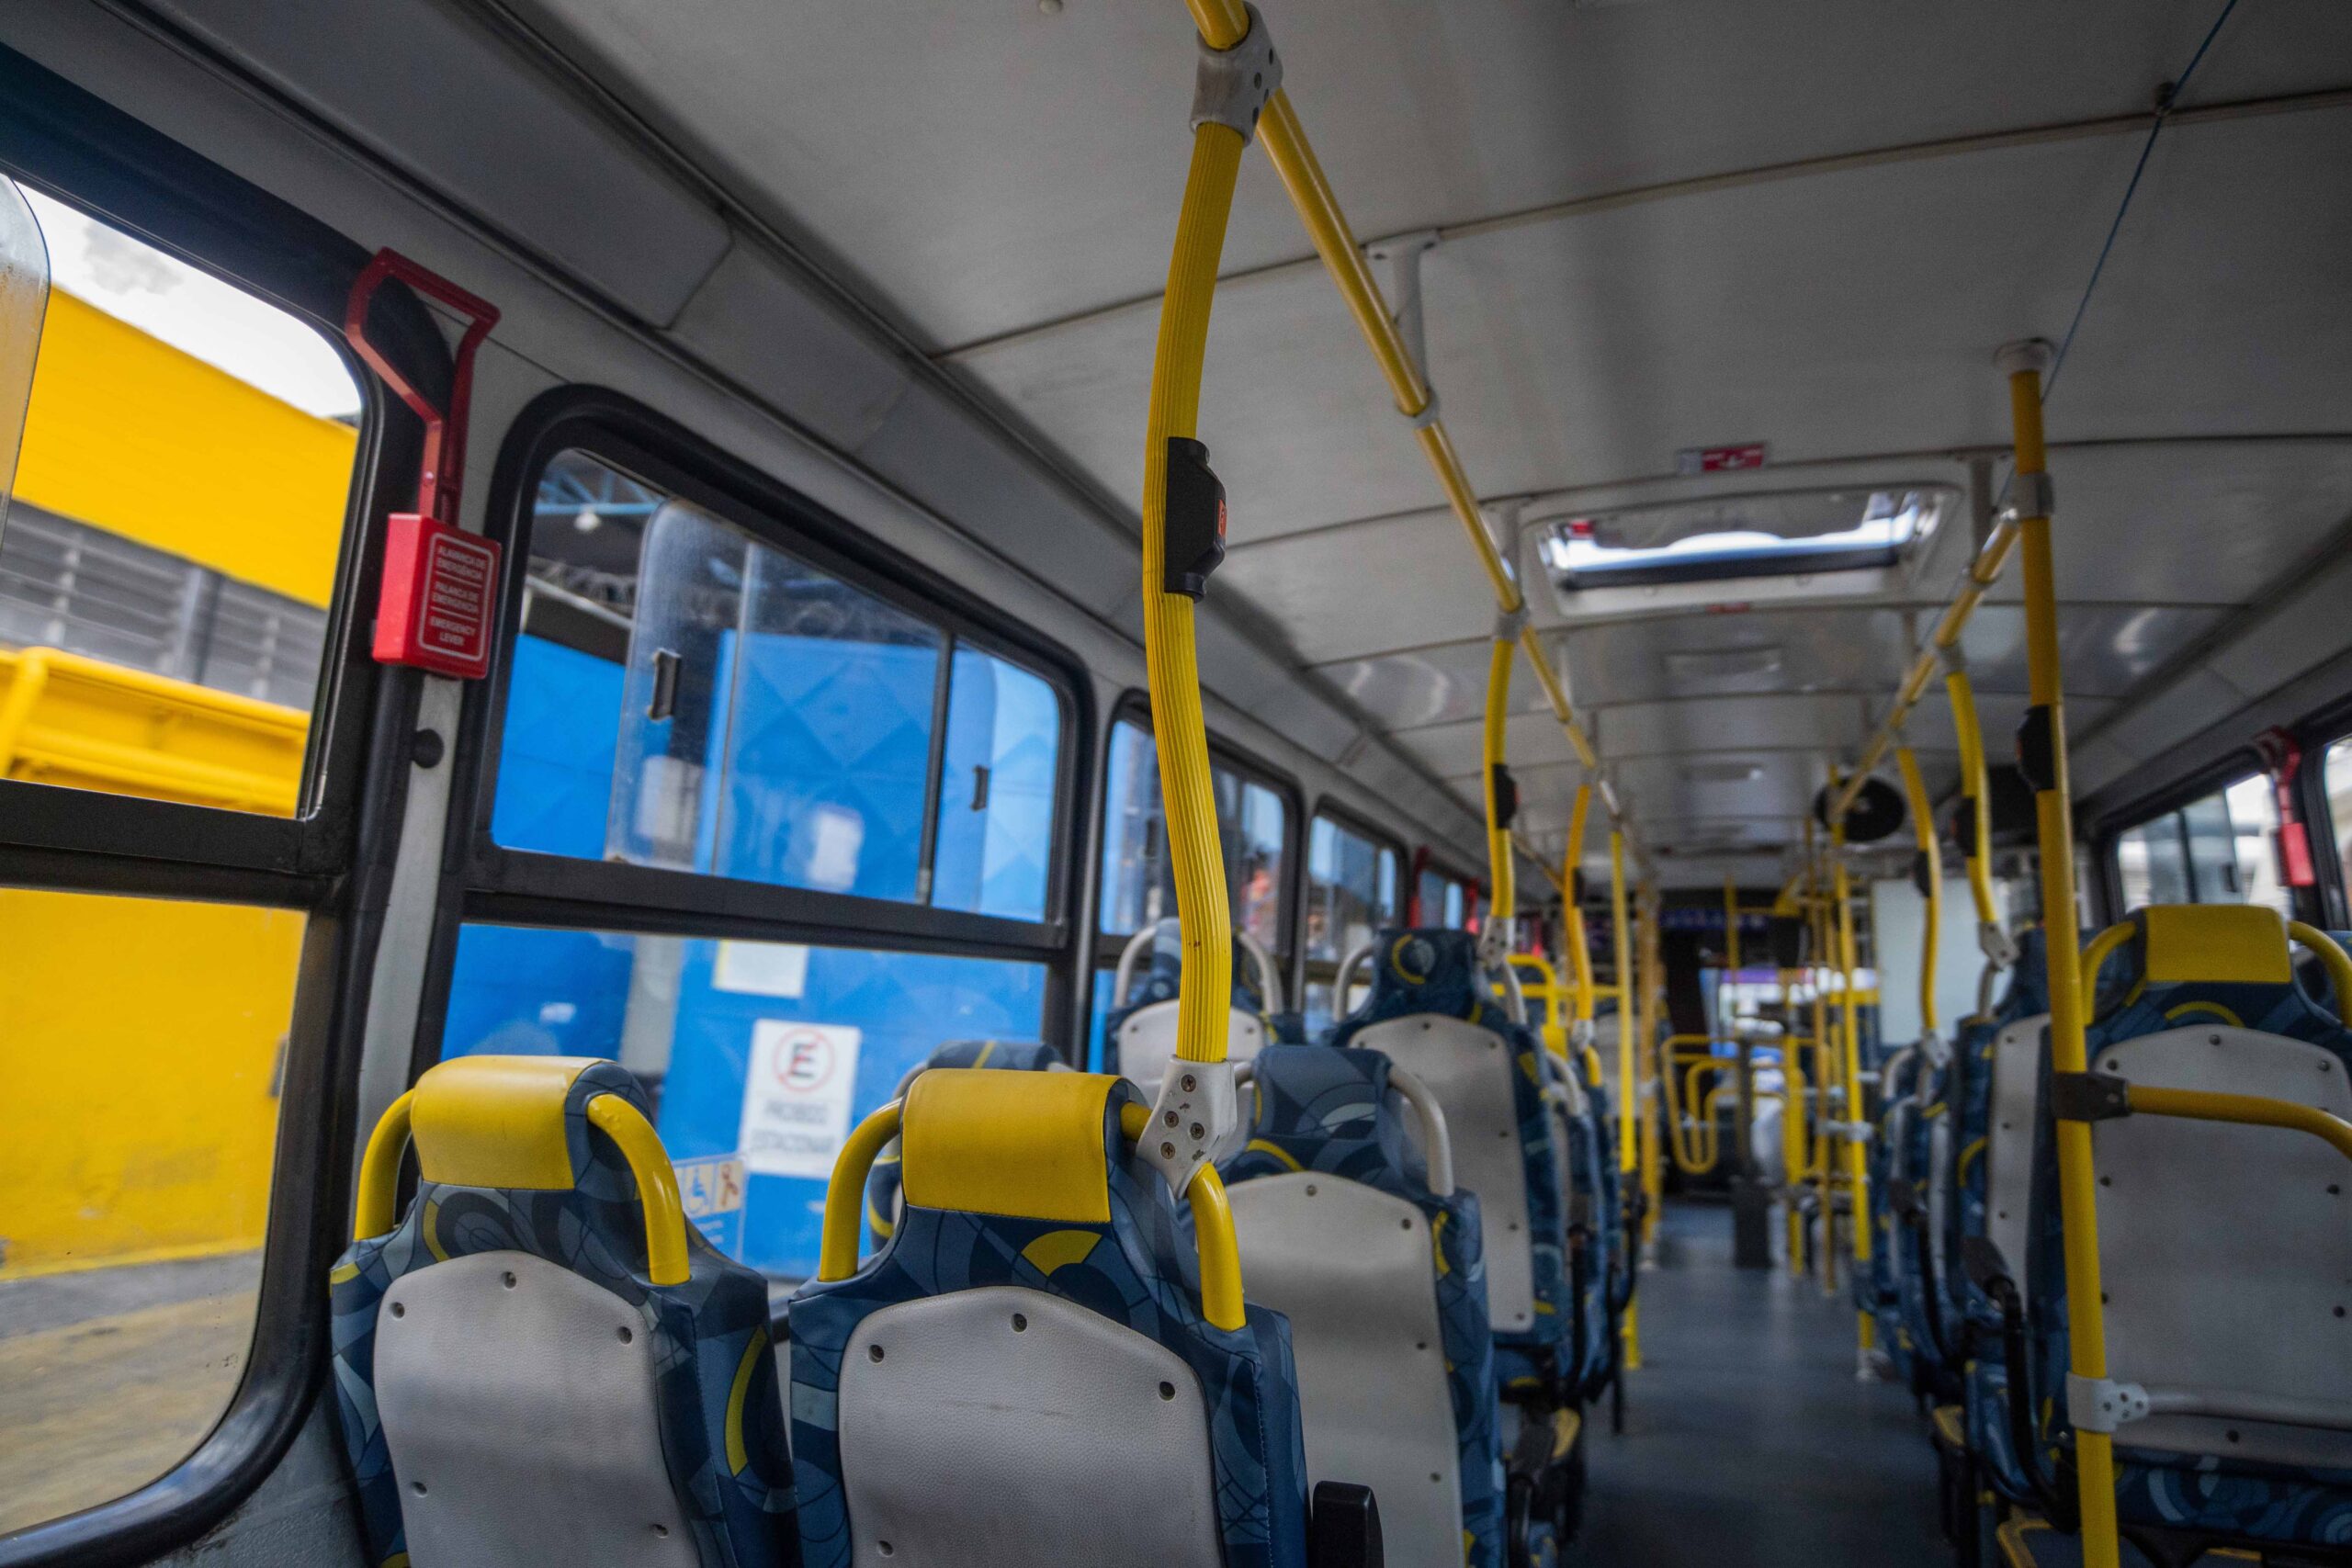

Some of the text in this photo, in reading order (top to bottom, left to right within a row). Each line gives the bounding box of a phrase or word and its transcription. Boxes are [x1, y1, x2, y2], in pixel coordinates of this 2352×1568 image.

[428, 615, 476, 637] EMERGENCY
[438, 631, 465, 646] LEVER
[788, 1042, 818, 1078] E
